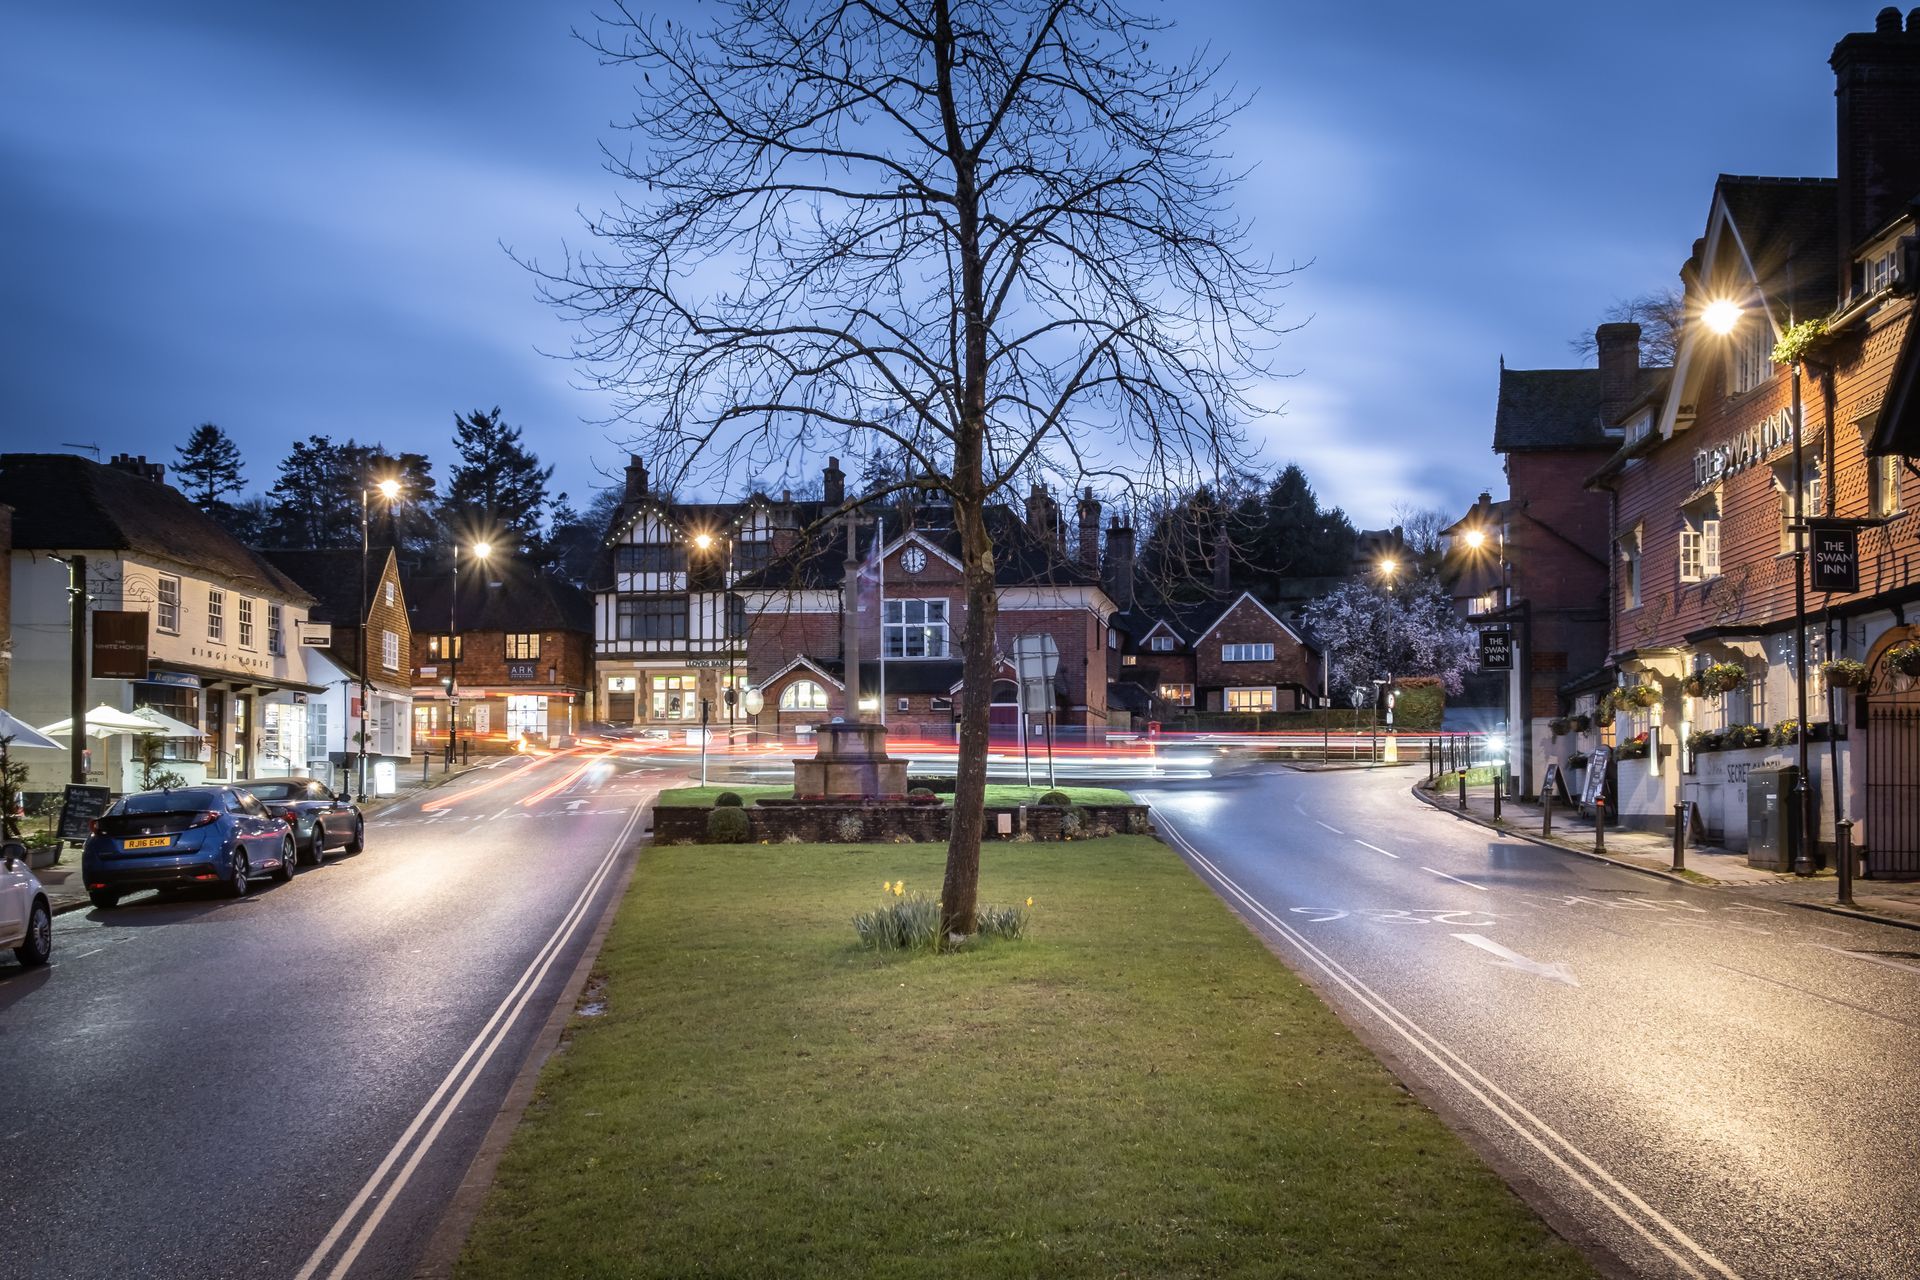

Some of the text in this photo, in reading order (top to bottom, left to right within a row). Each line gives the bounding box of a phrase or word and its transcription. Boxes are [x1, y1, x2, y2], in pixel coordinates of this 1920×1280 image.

[1693, 406, 1795, 484] THE SWAN INN
[1823, 541, 1845, 552] THE
[1816, 552, 1853, 563] SWAN
[1823, 564, 1847, 574] INN
[1489, 637, 1503, 645] THE
[191, 647, 227, 660] KINGS
[1484, 646, 1509, 654] SWAN
[685, 660, 730, 668] LLOYDS BANK
[511, 666, 534, 674] ARK
[1727, 763, 1751, 783] SECRET
[128, 838, 166, 848] RJ16 EHK
